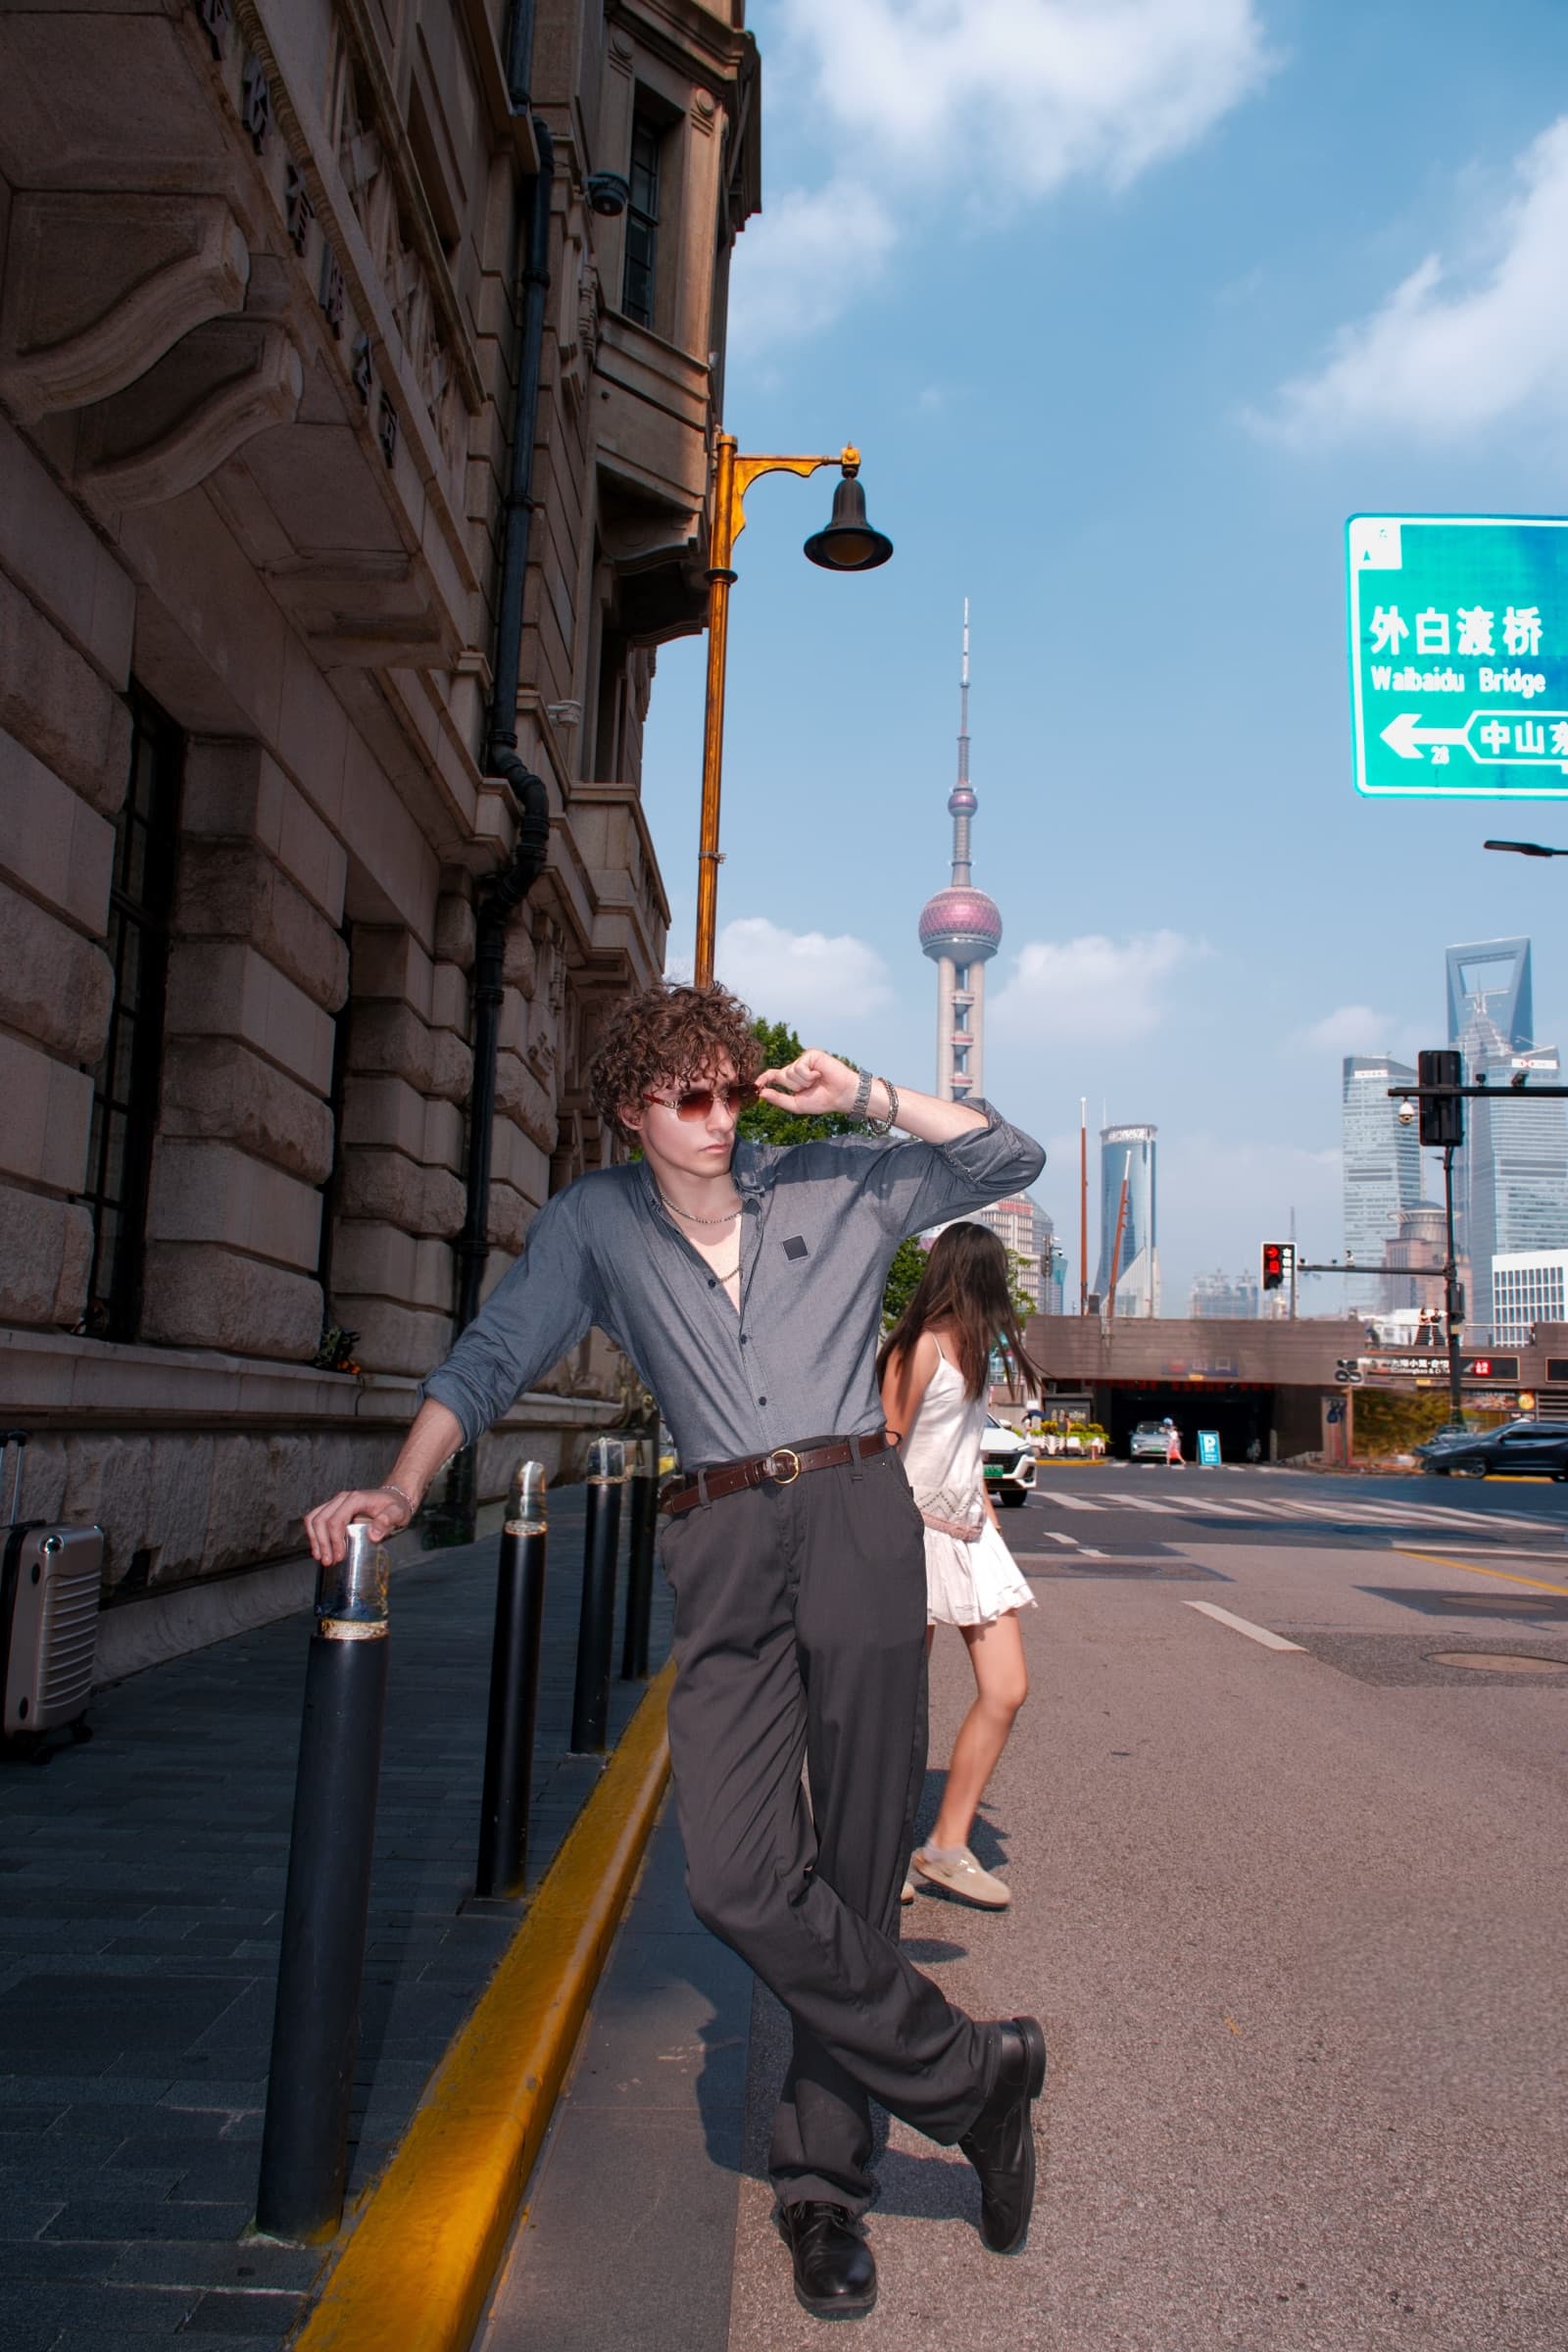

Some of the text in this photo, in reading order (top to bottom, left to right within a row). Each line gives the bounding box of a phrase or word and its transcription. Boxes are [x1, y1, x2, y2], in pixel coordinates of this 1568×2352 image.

[1370, 605, 1543, 656] 外白渡桥
[1371, 666, 1545, 699] Waibaidu Bridge
